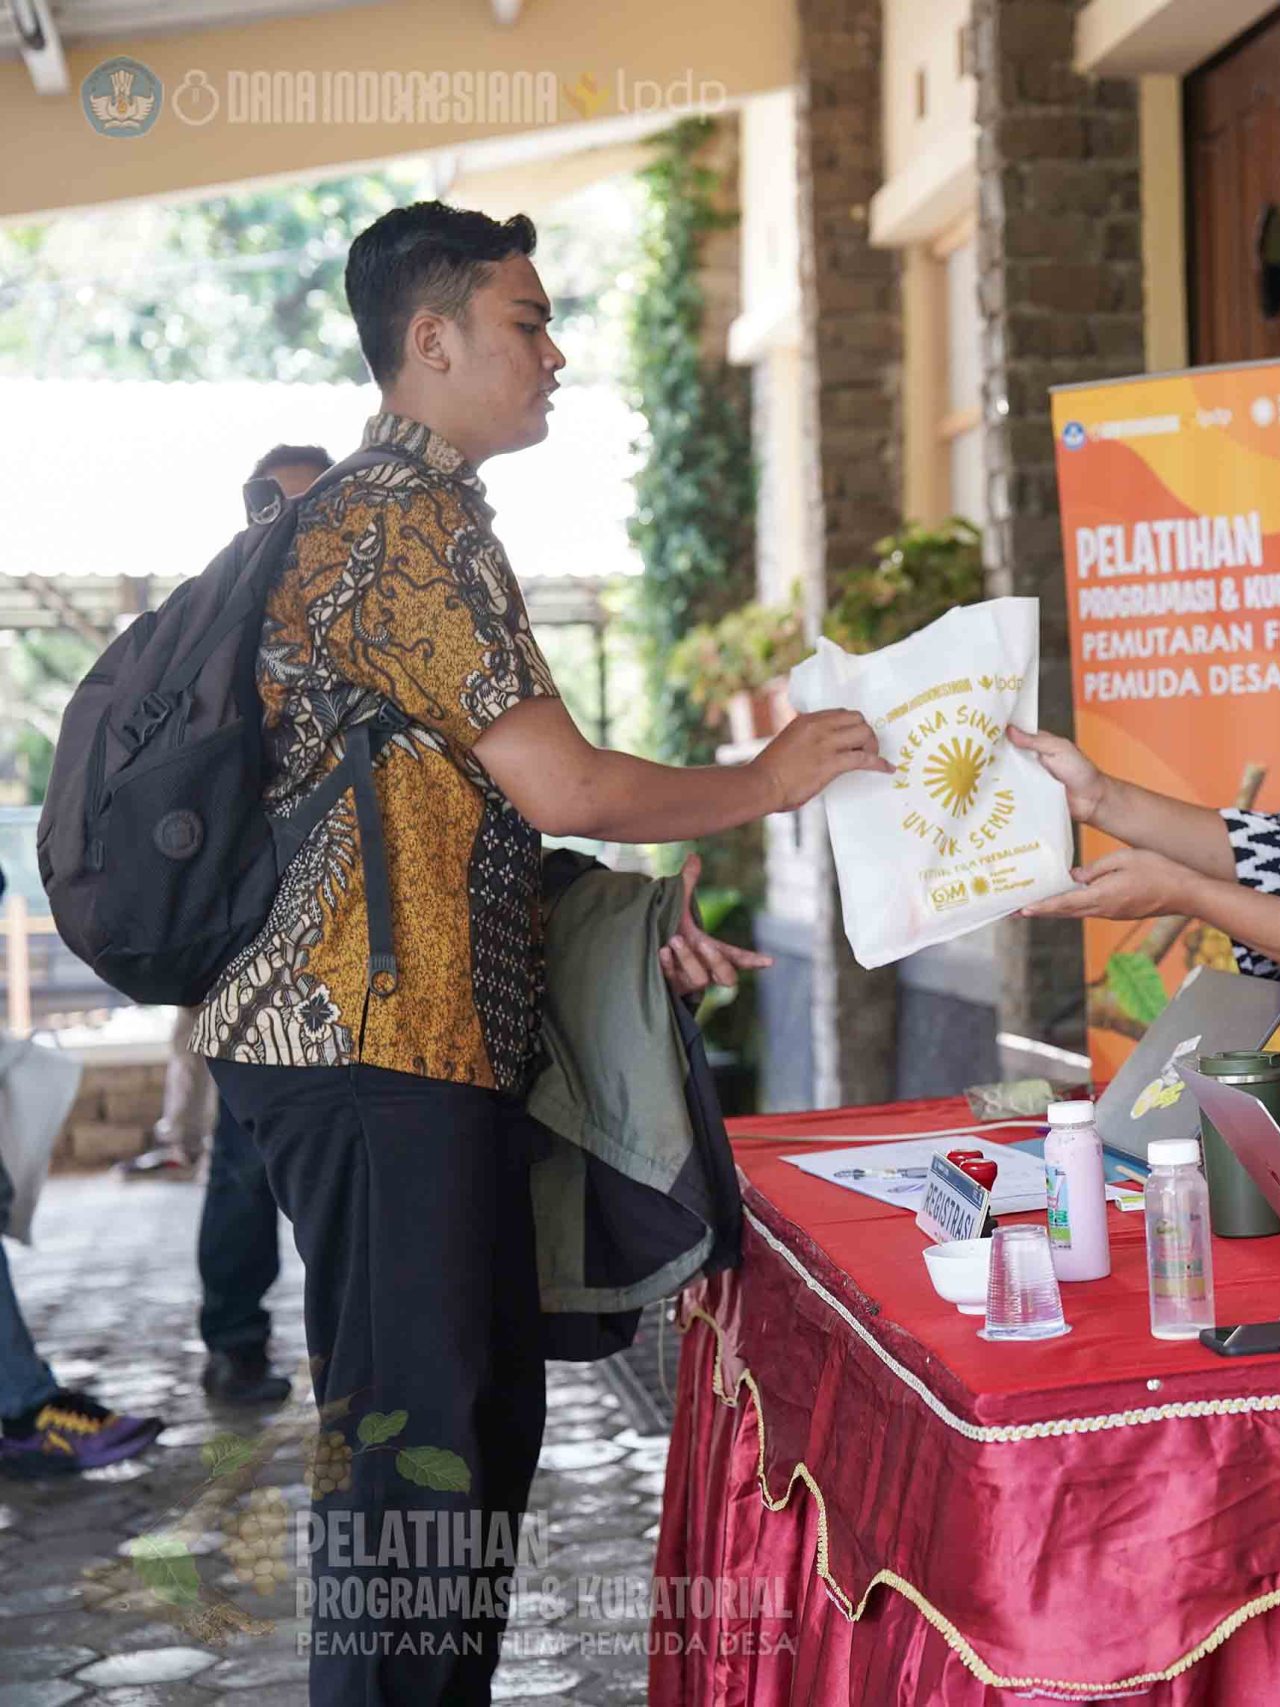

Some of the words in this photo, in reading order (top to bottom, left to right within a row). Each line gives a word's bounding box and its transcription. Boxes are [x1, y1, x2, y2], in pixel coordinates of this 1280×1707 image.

[1076, 512, 1263, 579] PELATIHAN
[1078, 576, 1217, 620] PROGRAMASI
[1219, 576, 1241, 612] &
[1081, 621, 1253, 661] PEMUTARAN
[1083, 667, 1202, 702] PEMUDA
[893, 710, 947, 790] KARENA
[969, 789, 1015, 849] SEMUA
[924, 1182, 975, 1241] REGISTRASI
